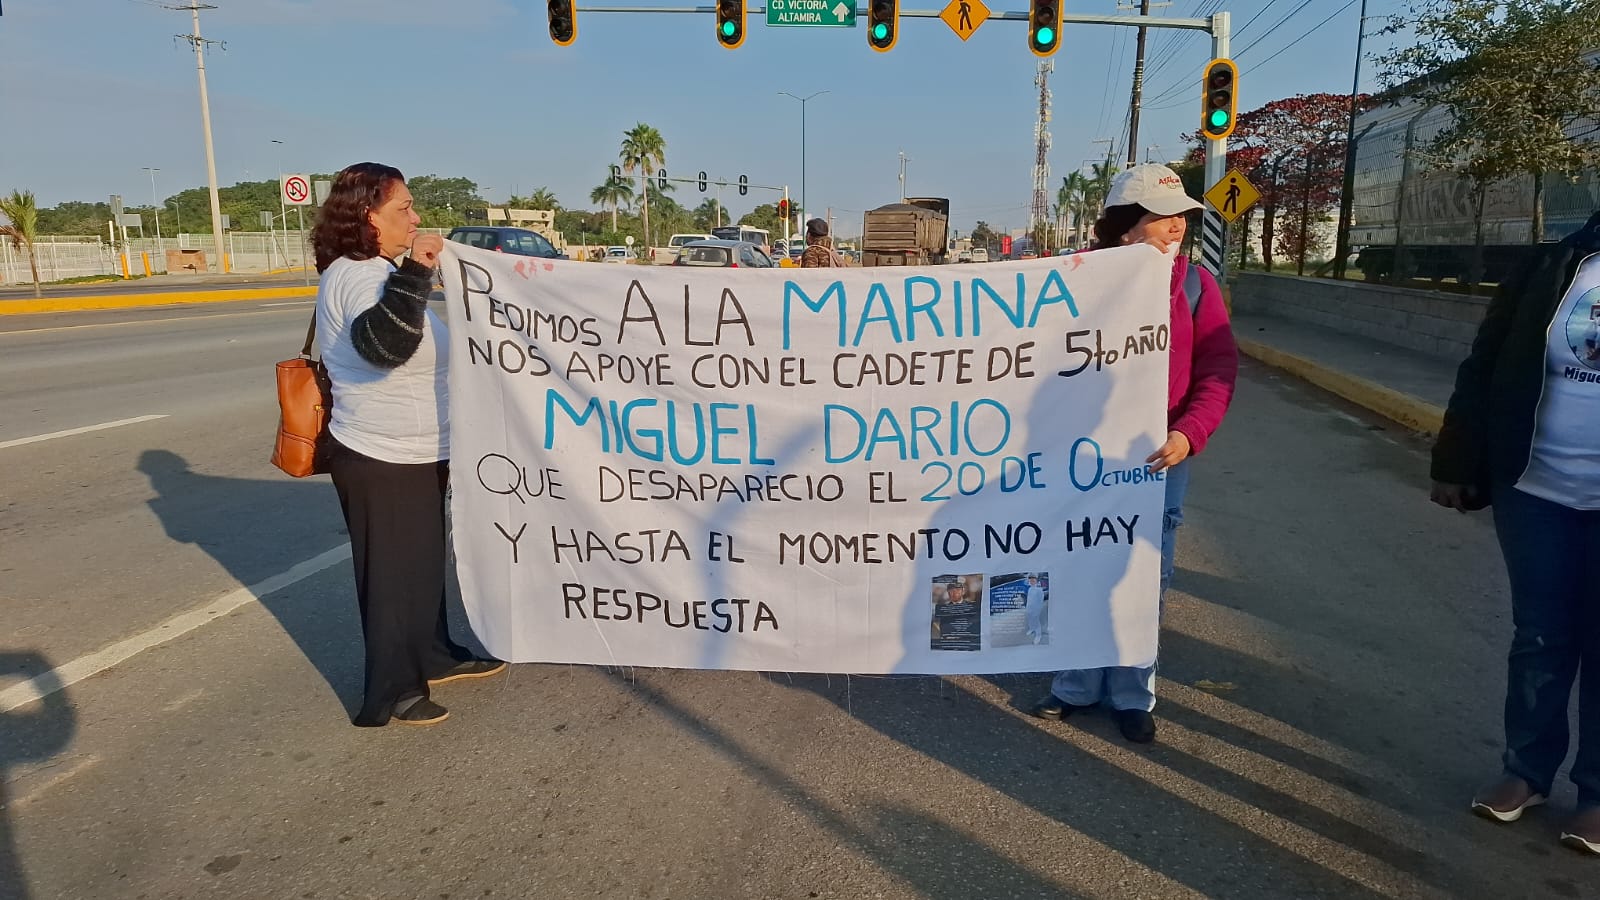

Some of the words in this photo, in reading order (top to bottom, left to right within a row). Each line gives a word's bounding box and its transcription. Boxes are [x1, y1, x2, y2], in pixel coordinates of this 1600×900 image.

[778, 13, 822, 22] ALTAMIRA
[788, 0, 828, 9] VICTORIA
[458, 258, 601, 347] PEDIMOS
[617, 279, 666, 346] A
[684, 284, 755, 346] LA
[783, 269, 1079, 350] MARINA
[468, 336, 552, 377] NOS
[566, 351, 674, 386] APOYE
[691, 353, 770, 389] CON
[779, 356, 817, 387] EL
[832, 348, 974, 389] CADETE
[987, 341, 1036, 382] DE
[1122, 324, 1169, 360] AÑO
[544, 388, 775, 466] MIGUEL
[823, 398, 1011, 464] DARIO
[476, 453, 567, 505] QUE
[599, 465, 845, 503] DESAPARECIO
[868, 471, 907, 503] EL
[920, 460, 985, 502] 20
[1001, 452, 1046, 492] DE
[1069, 437, 1165, 491] OCTUBRE
[494, 522, 527, 563] Y
[551, 525, 691, 564] HASTA
[708, 531, 745, 563] EL
[779, 528, 970, 566] MOMENTO
[984, 521, 1042, 559] NO
[1066, 514, 1139, 552] HAY
[562, 583, 779, 633] RESPUESTA
